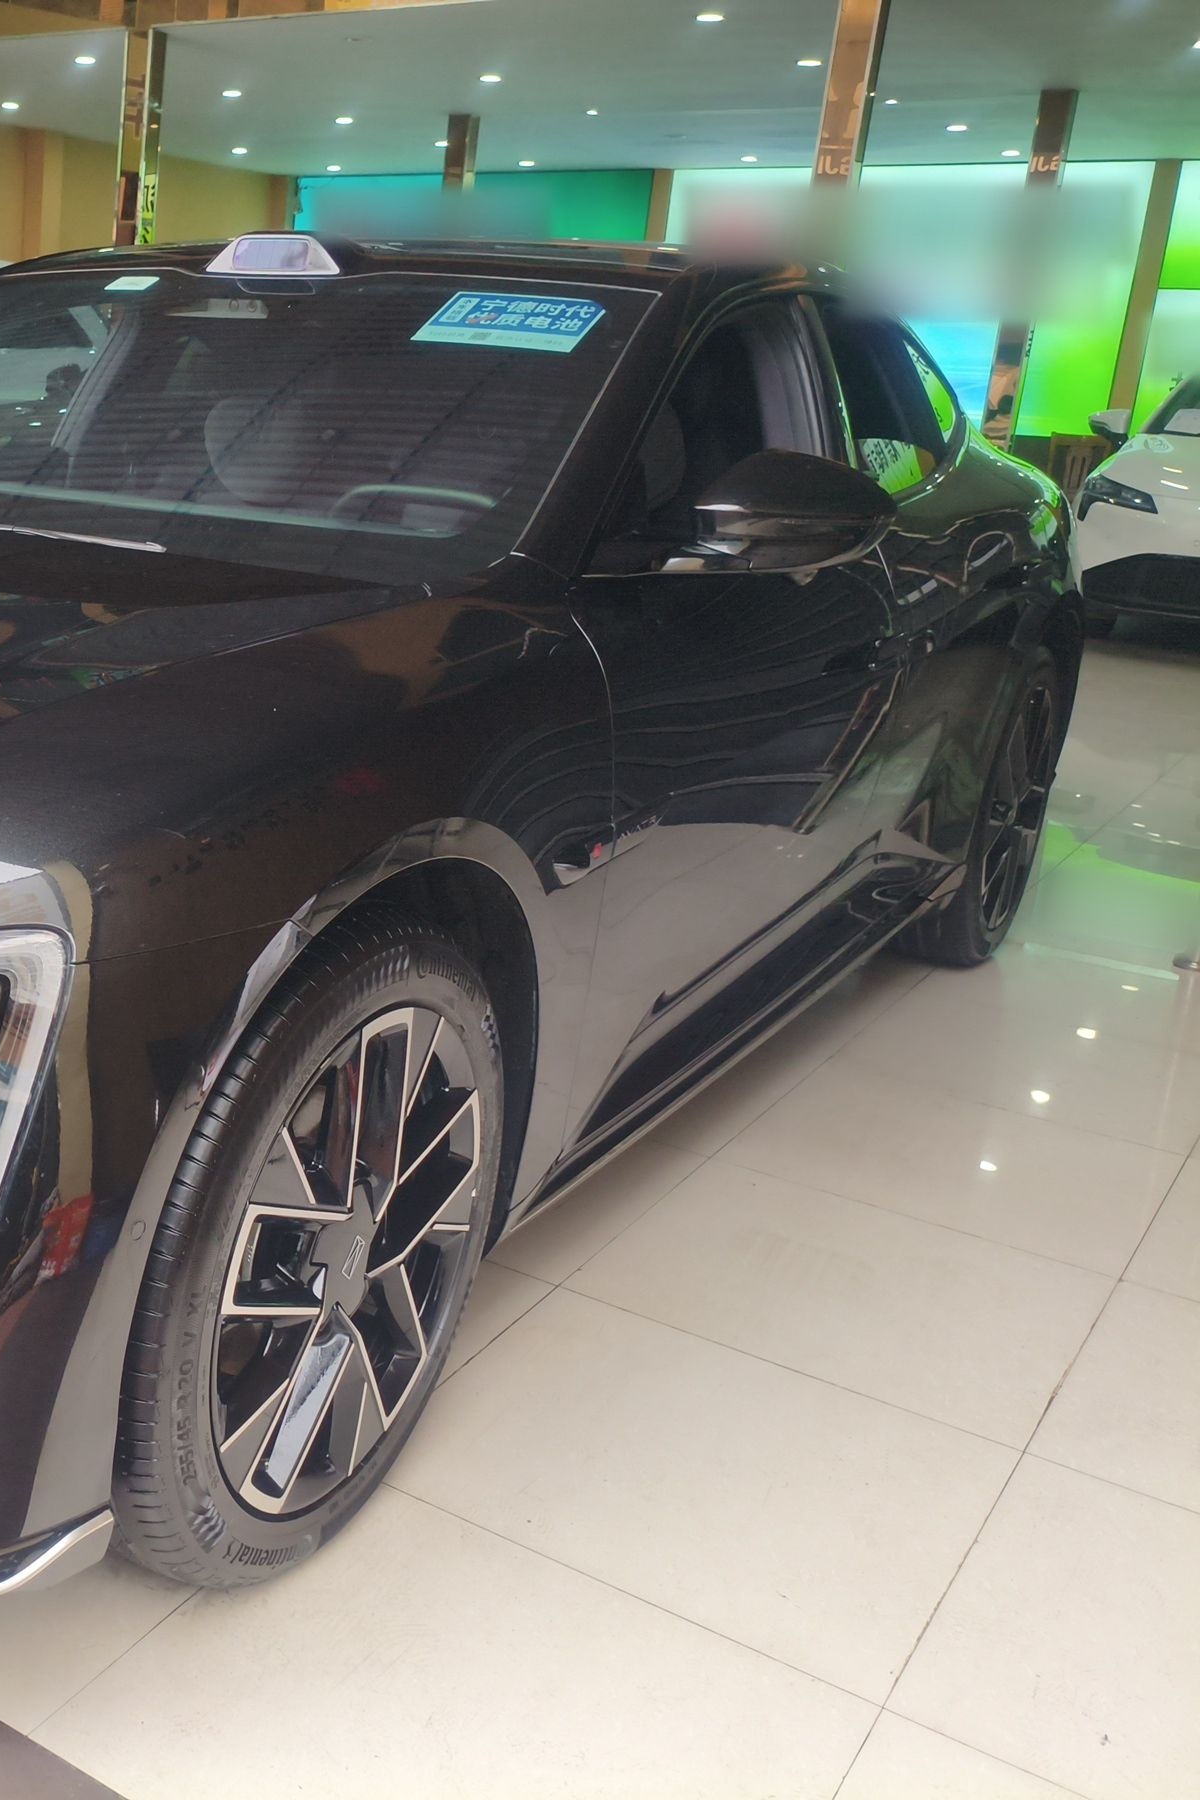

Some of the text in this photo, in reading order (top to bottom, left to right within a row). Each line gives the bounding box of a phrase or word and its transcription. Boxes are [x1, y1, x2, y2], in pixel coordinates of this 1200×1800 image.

[480, 299, 596, 319] 宁德时代
[465, 311, 583, 332] 优质电池
